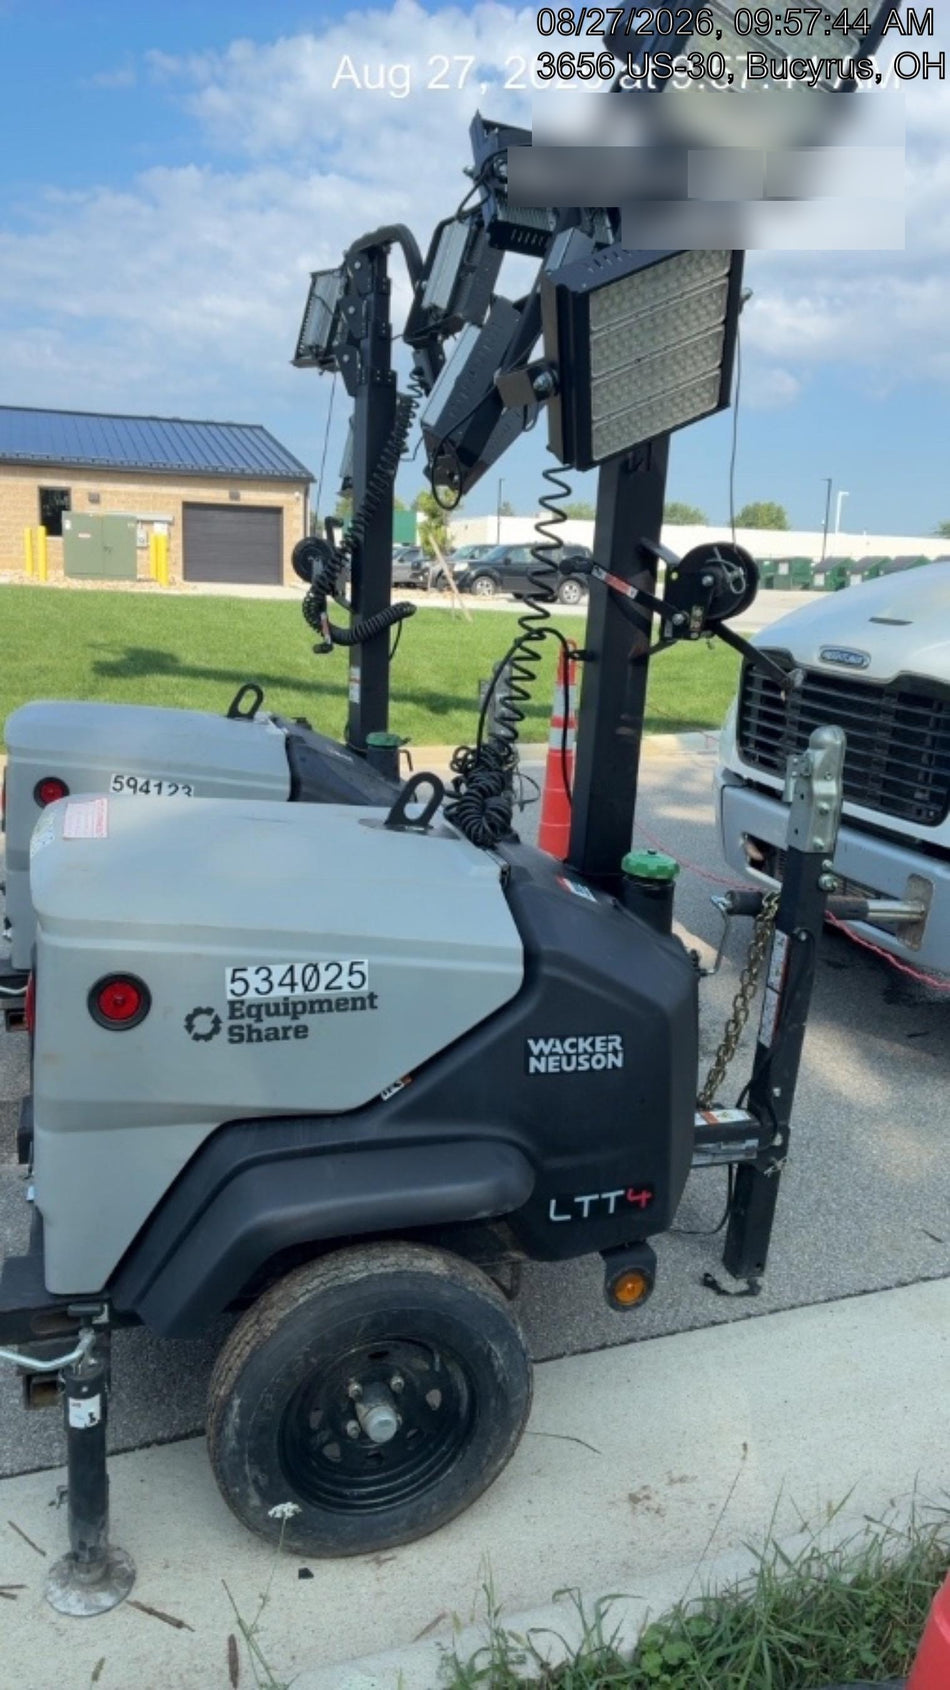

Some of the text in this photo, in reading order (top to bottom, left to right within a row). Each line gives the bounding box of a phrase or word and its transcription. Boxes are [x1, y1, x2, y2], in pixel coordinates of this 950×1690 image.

[229, 961, 367, 997] 534025
[227, 992, 378, 1022] Equipment
[227, 1023, 309, 1044] Share
[527, 1034, 623, 1056] WACKER
[529, 1051, 624, 1073] NEUSON
[549, 1188, 652, 1221] LTT4
